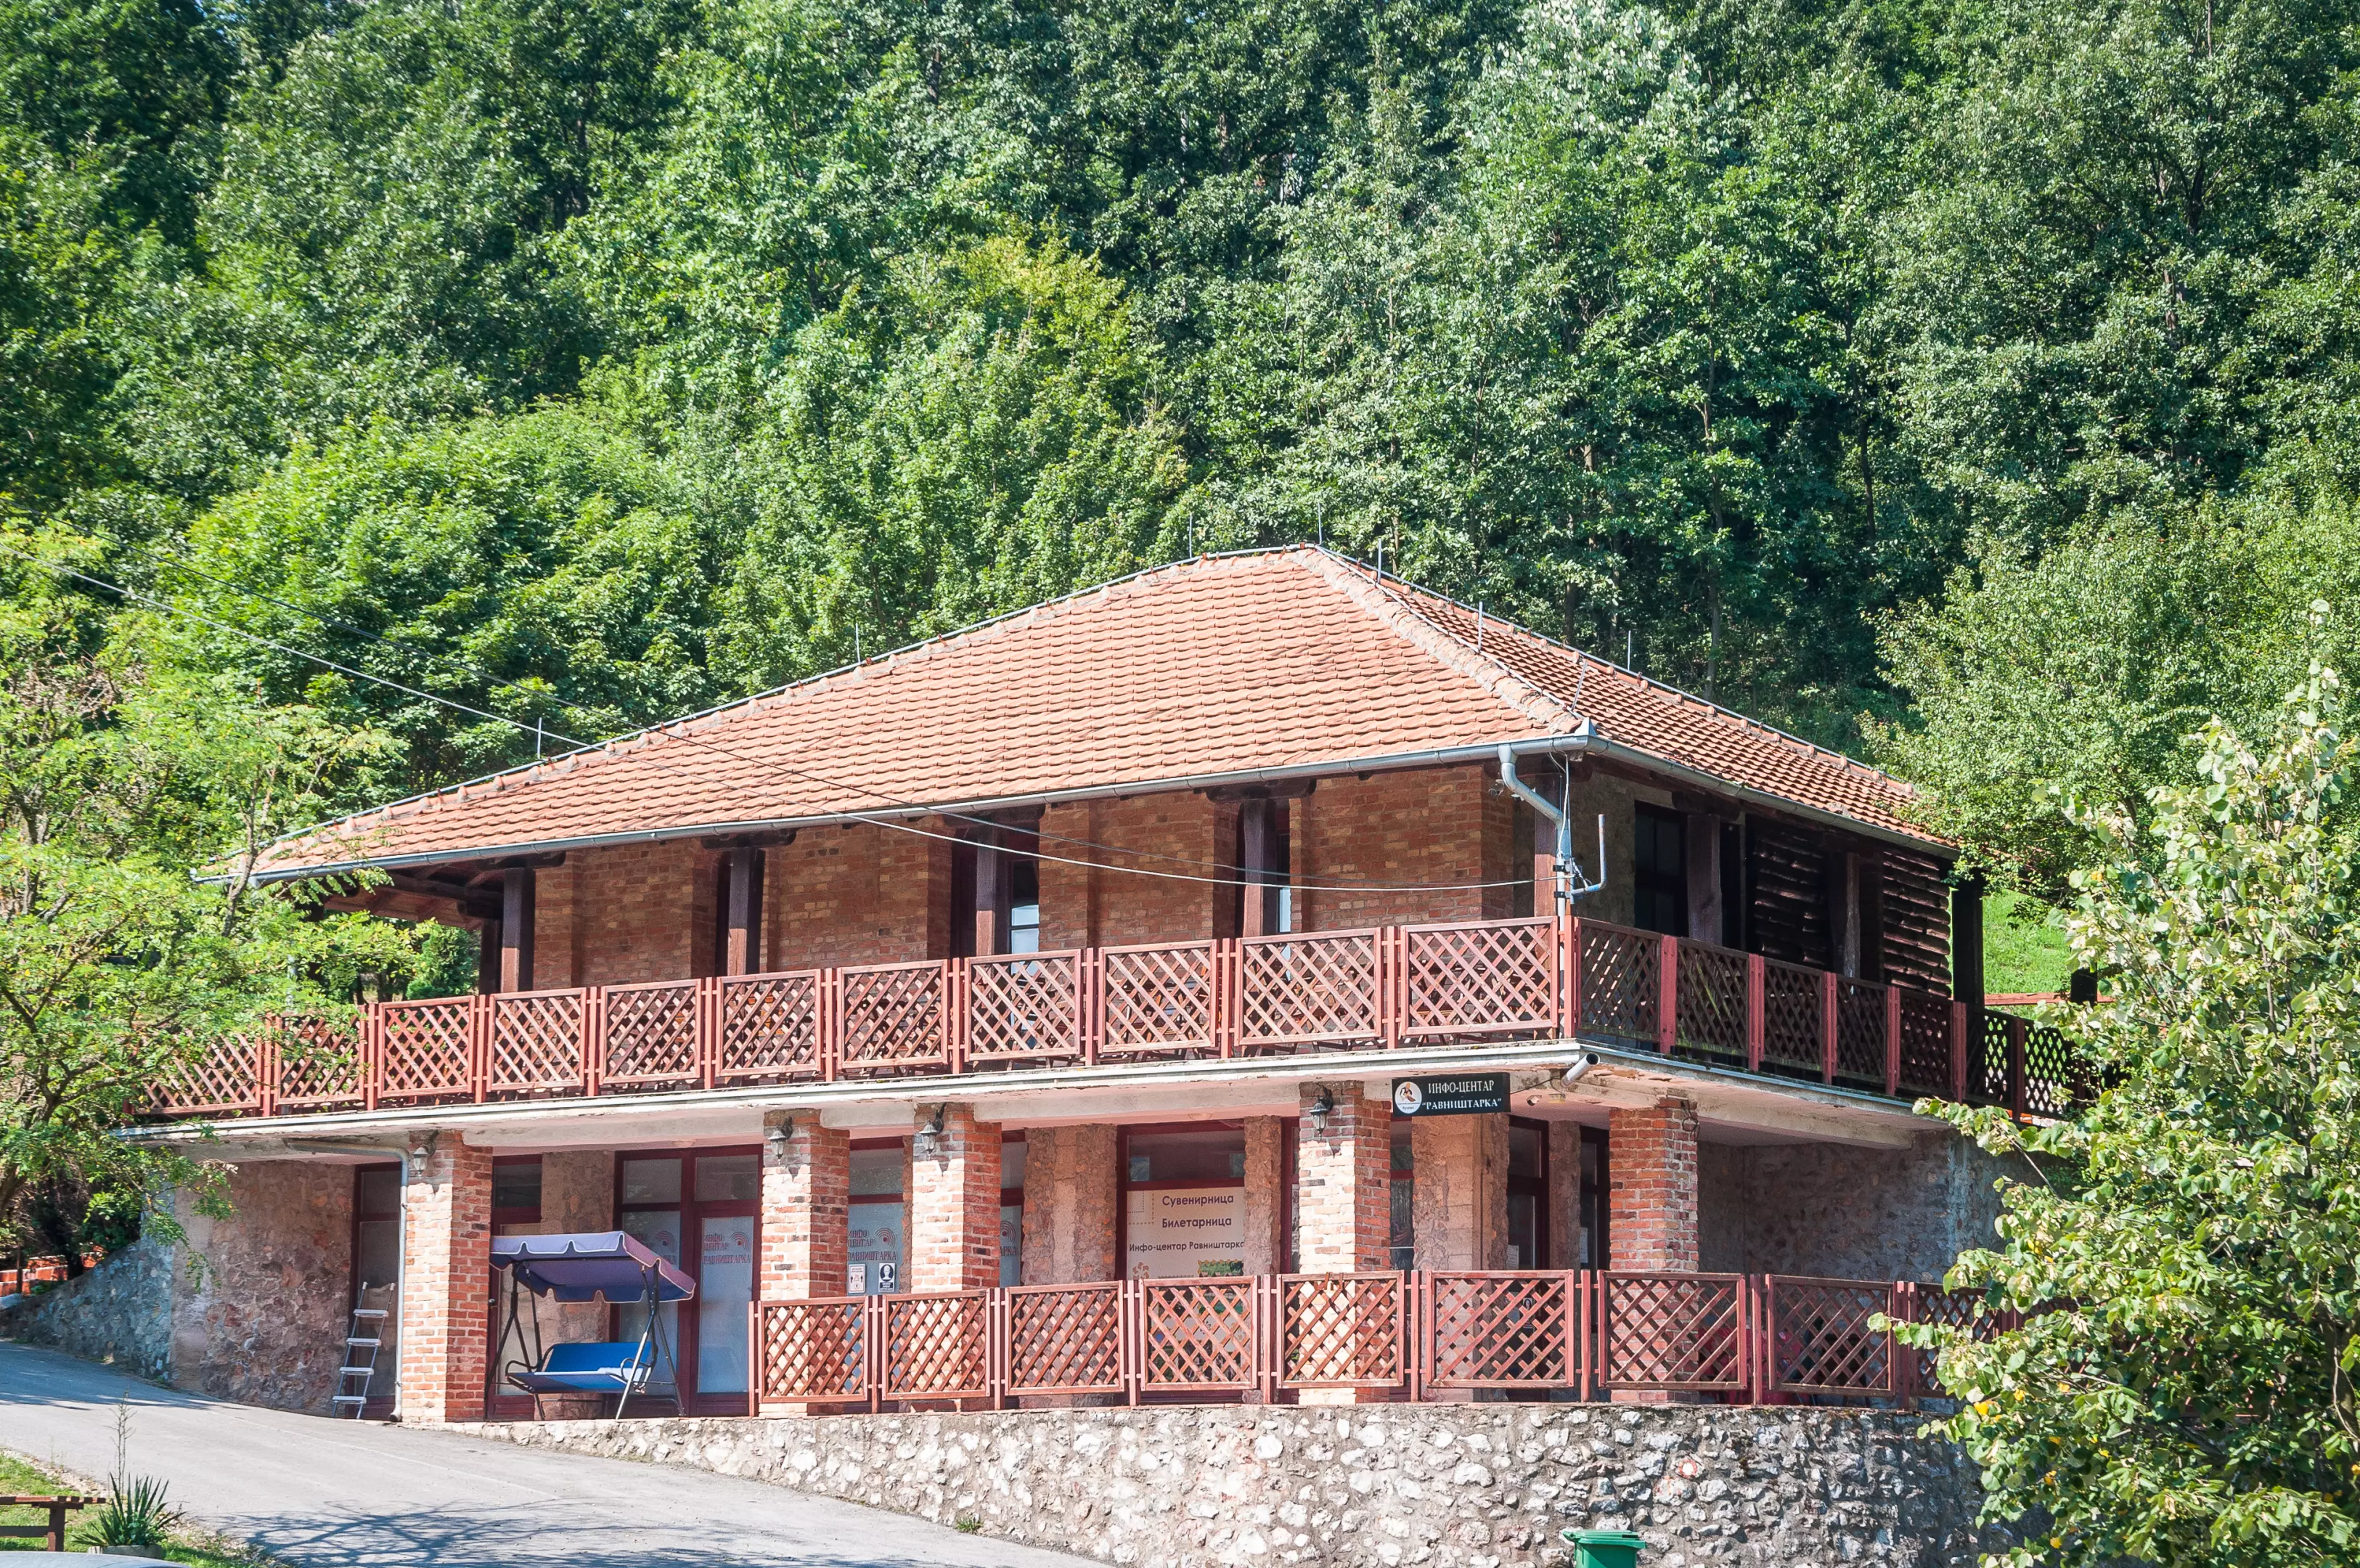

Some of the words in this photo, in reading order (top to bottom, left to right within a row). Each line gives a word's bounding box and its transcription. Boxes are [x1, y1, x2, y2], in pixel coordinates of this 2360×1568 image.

[1428, 1080, 1494, 1093] ИНФО-ЦЕНТАР
[1162, 1194, 1234, 1207] Сувенирница
[1162, 1217, 1232, 1228] Билетарница
[848, 1228, 868, 1238] ИНФО
[847, 1238, 874, 1247] ЦЕНТАР
[1130, 1242, 1187, 1253] Инфо-центар
[847, 1250, 897, 1262] РАВНИШТАРКА
